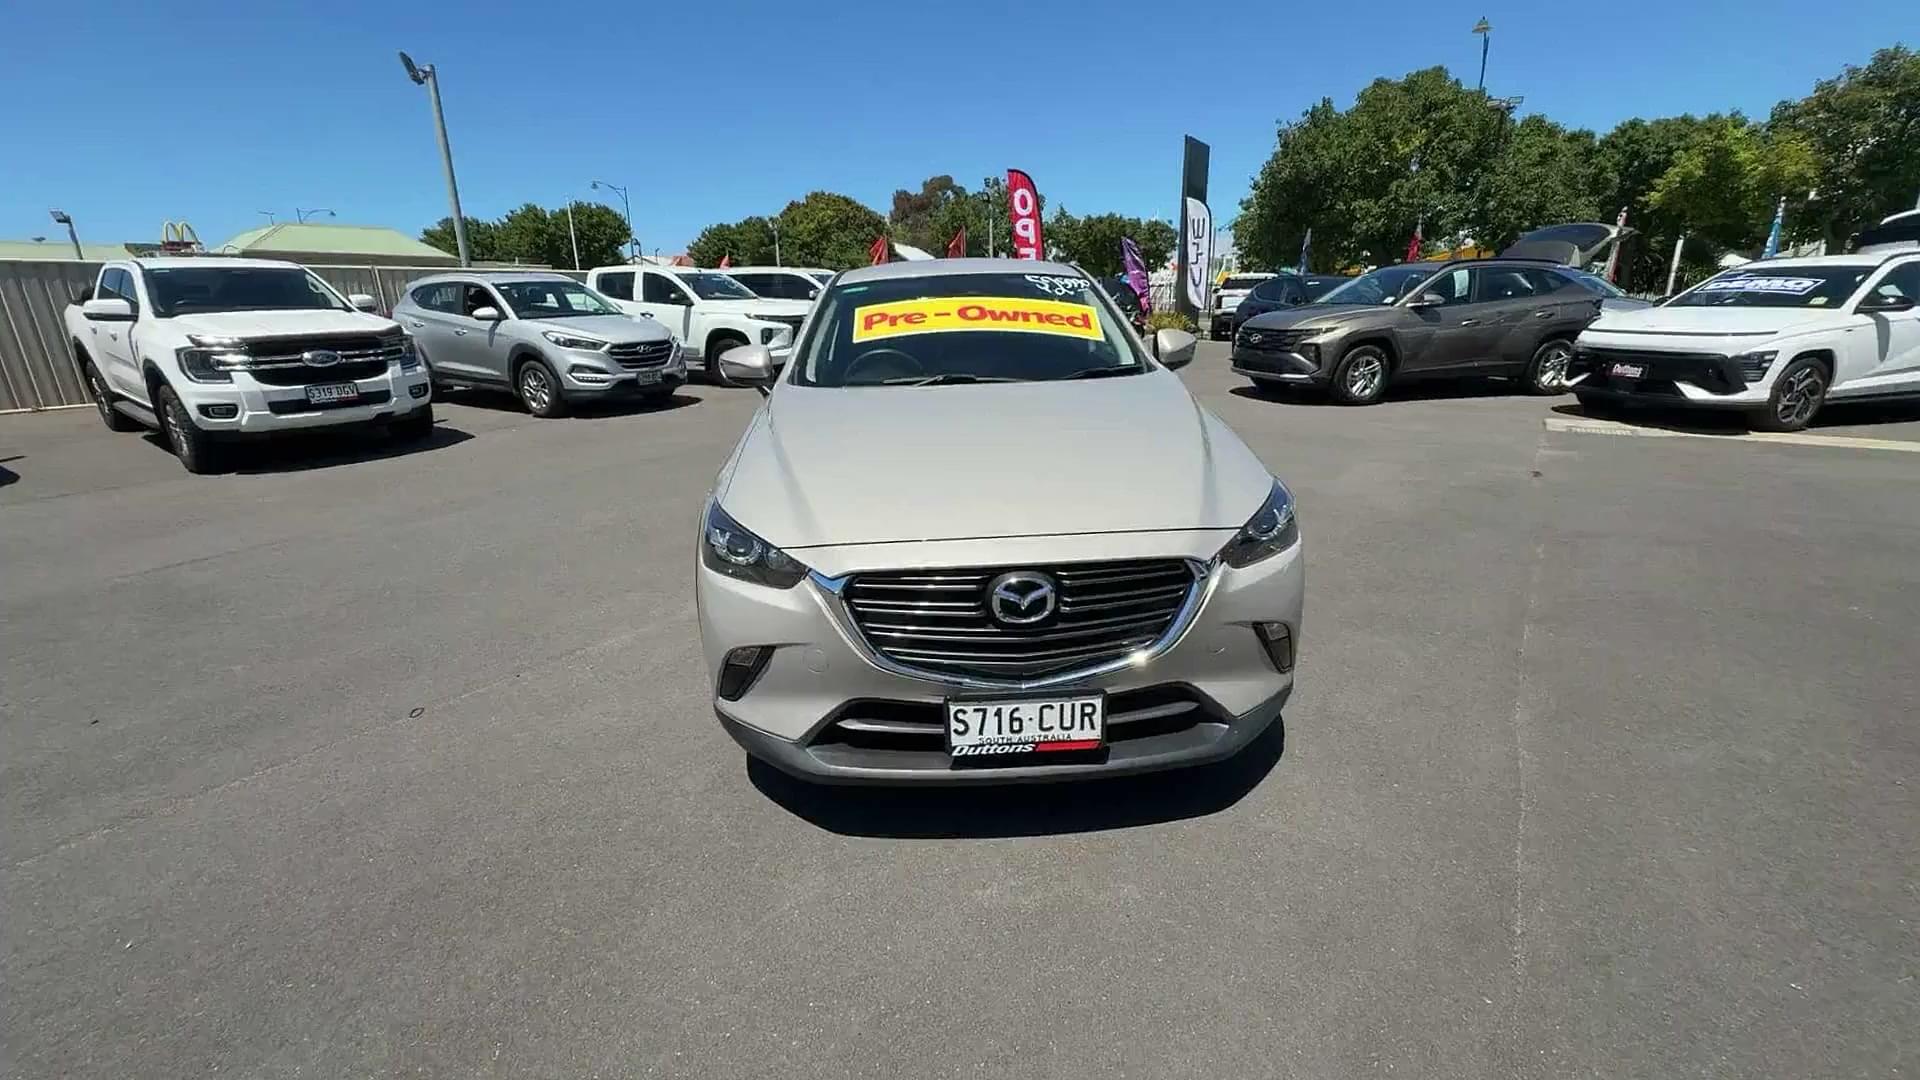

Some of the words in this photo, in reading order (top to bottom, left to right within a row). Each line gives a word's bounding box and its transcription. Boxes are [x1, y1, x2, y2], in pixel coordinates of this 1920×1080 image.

[863, 312, 927, 330] Pre
[957, 305, 1092, 330] Owned
[979, 736, 1013, 745] SOUTH
[1017, 733, 1073, 743] AUSTRALIA
[951, 743, 1036, 756] Duttons
